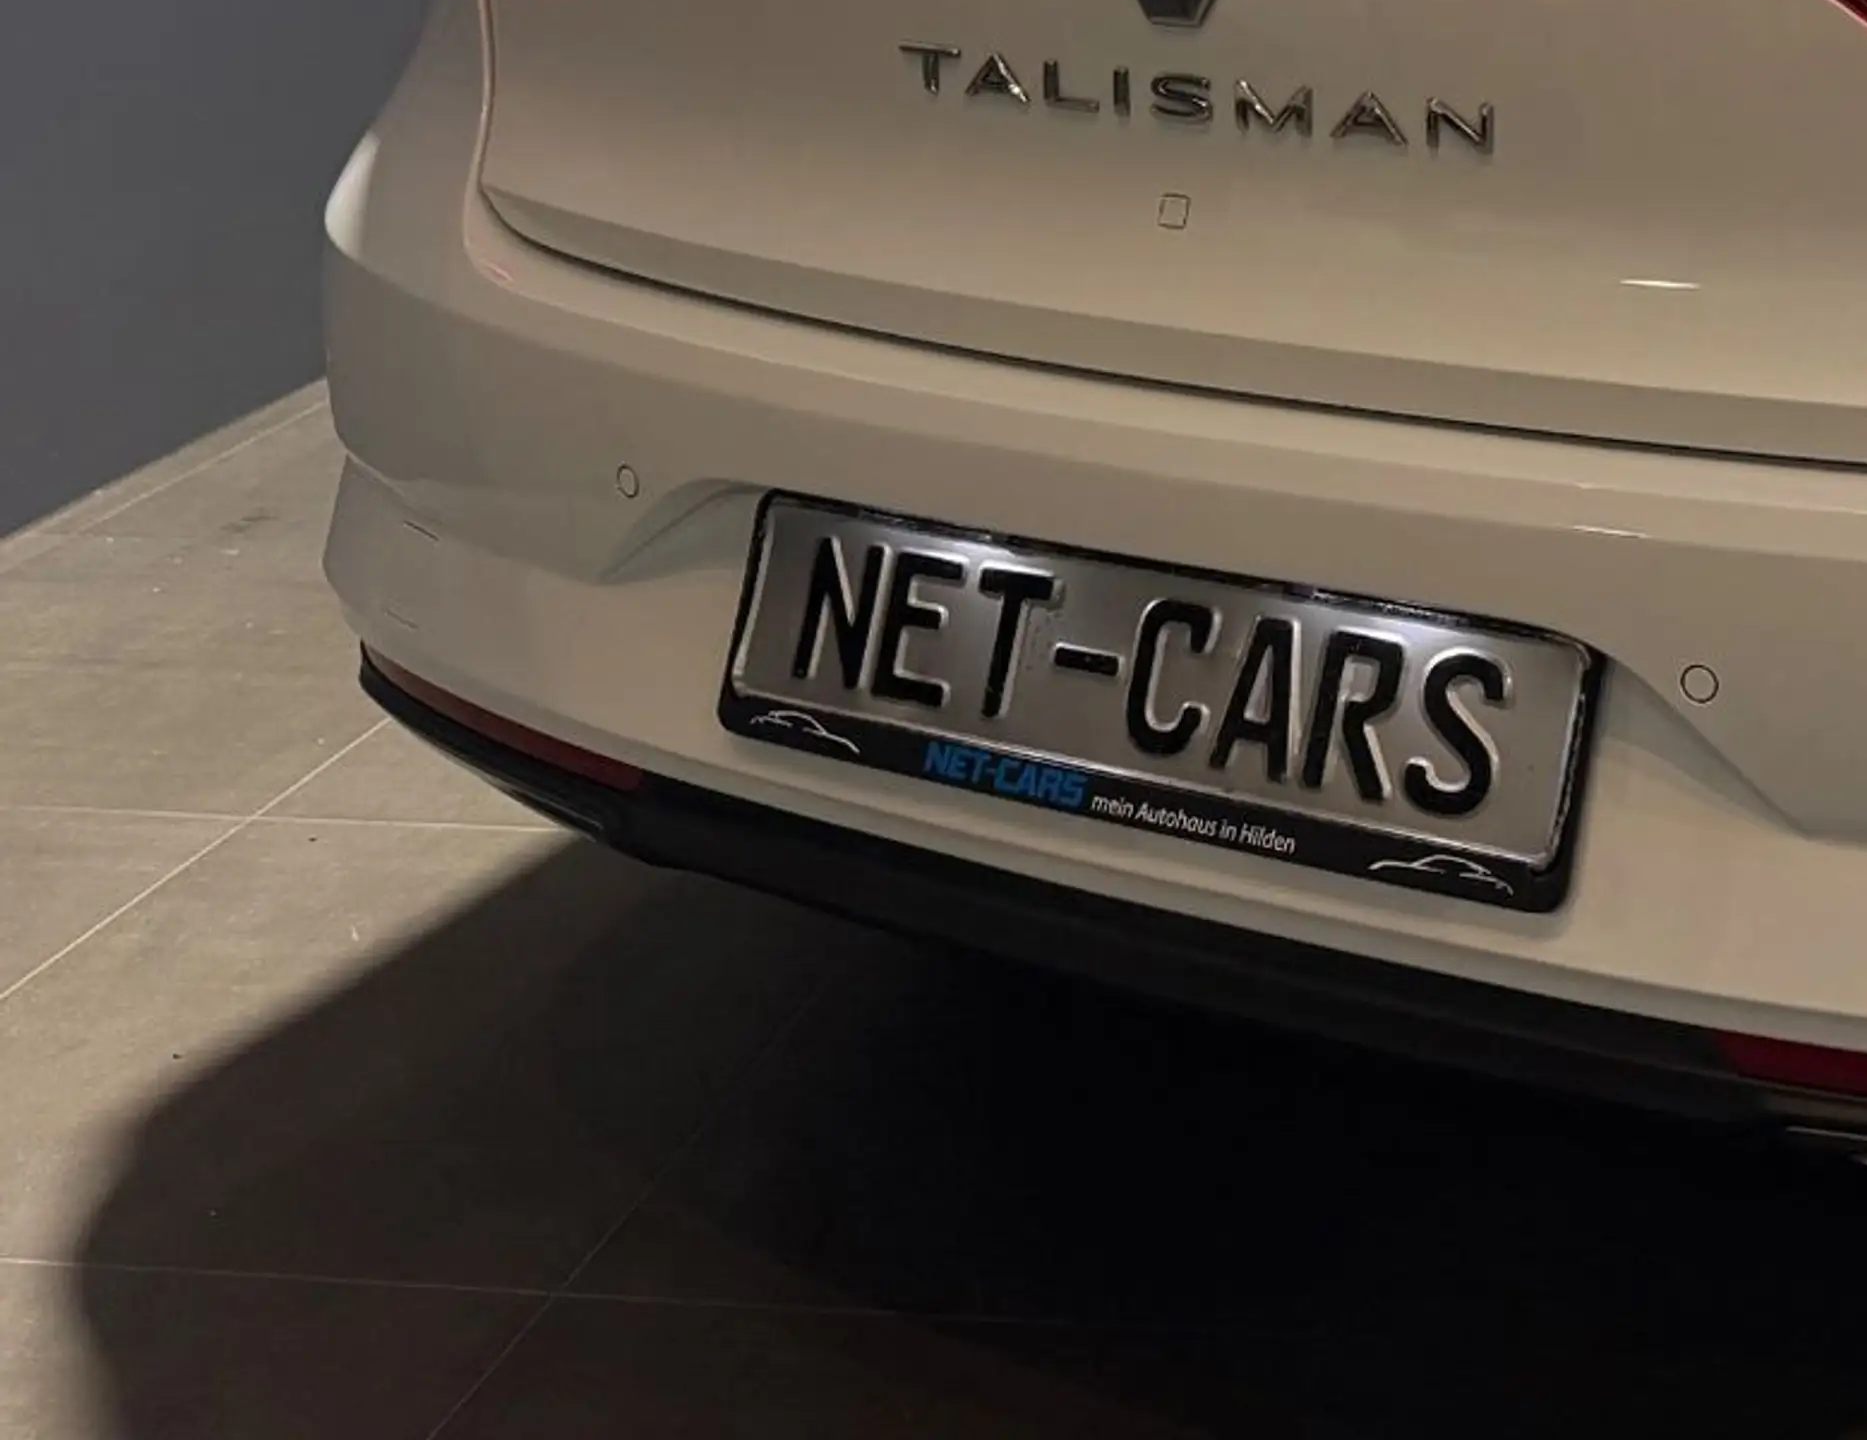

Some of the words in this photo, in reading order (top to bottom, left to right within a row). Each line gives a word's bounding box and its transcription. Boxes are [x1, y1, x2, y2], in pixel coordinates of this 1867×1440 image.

[899, 39, 1496, 156] TALISMAN
[792, 534, 1512, 816] NET-CARS
[922, 741, 1090, 808] NET-CARS
[1091, 795, 1134, 819] mein
[1136, 802, 1217, 838] Autohaus
[1219, 818, 1238, 840] in
[1239, 821, 1296, 856] Hilden
